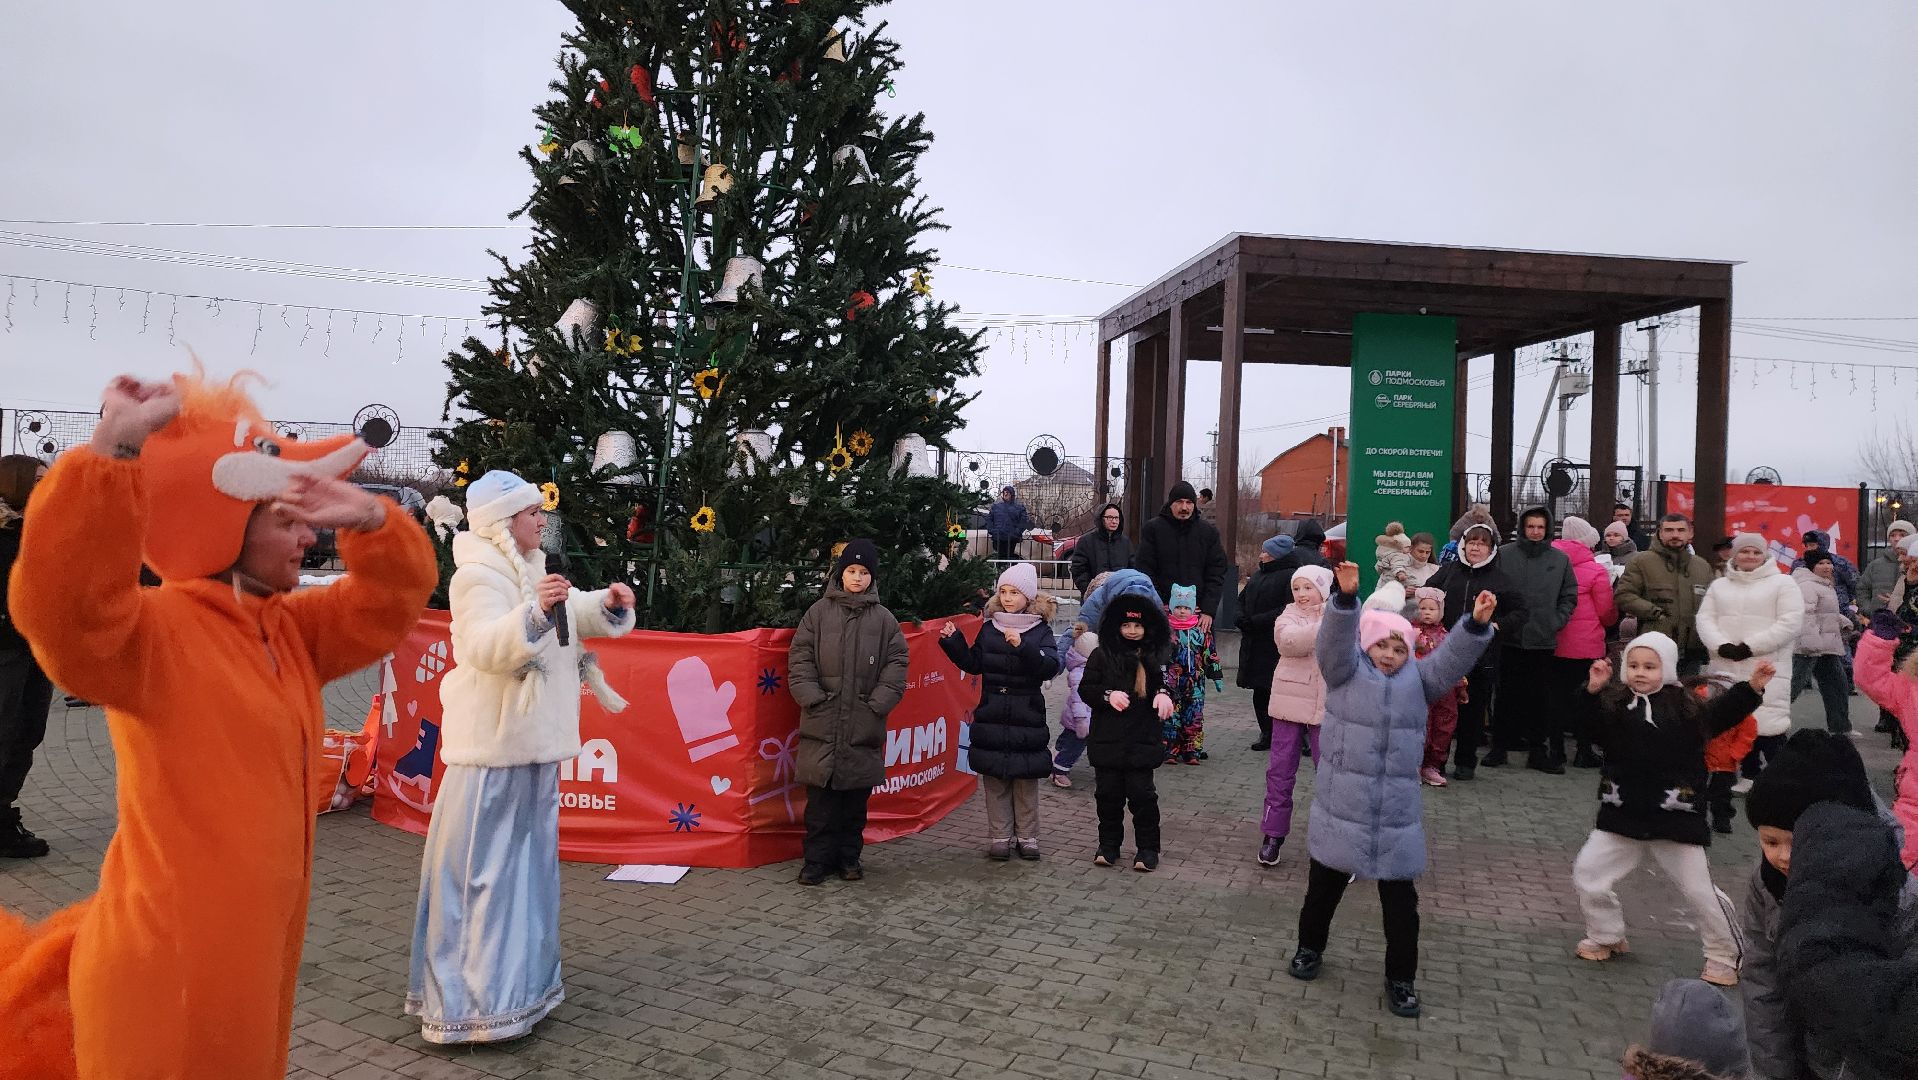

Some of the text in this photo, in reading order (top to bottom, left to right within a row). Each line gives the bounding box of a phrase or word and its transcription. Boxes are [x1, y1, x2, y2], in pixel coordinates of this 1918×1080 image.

[1385, 377, 1446, 387] ПОДМОСКОВЬЯ
[1392, 401, 1437, 409] СЕРЕБРЯНЫЙ
[1365, 447, 1443, 457] ДО СКОРОЙ ВСТРЕЧИ!
[1373, 470, 1434, 479] МЫ ВСЕГДА ВАМ
[1376, 479, 1398, 487] РАДЫ
[1405, 480, 1430, 488] ПАРКЕ
[884, 716, 947, 768] ИМА
